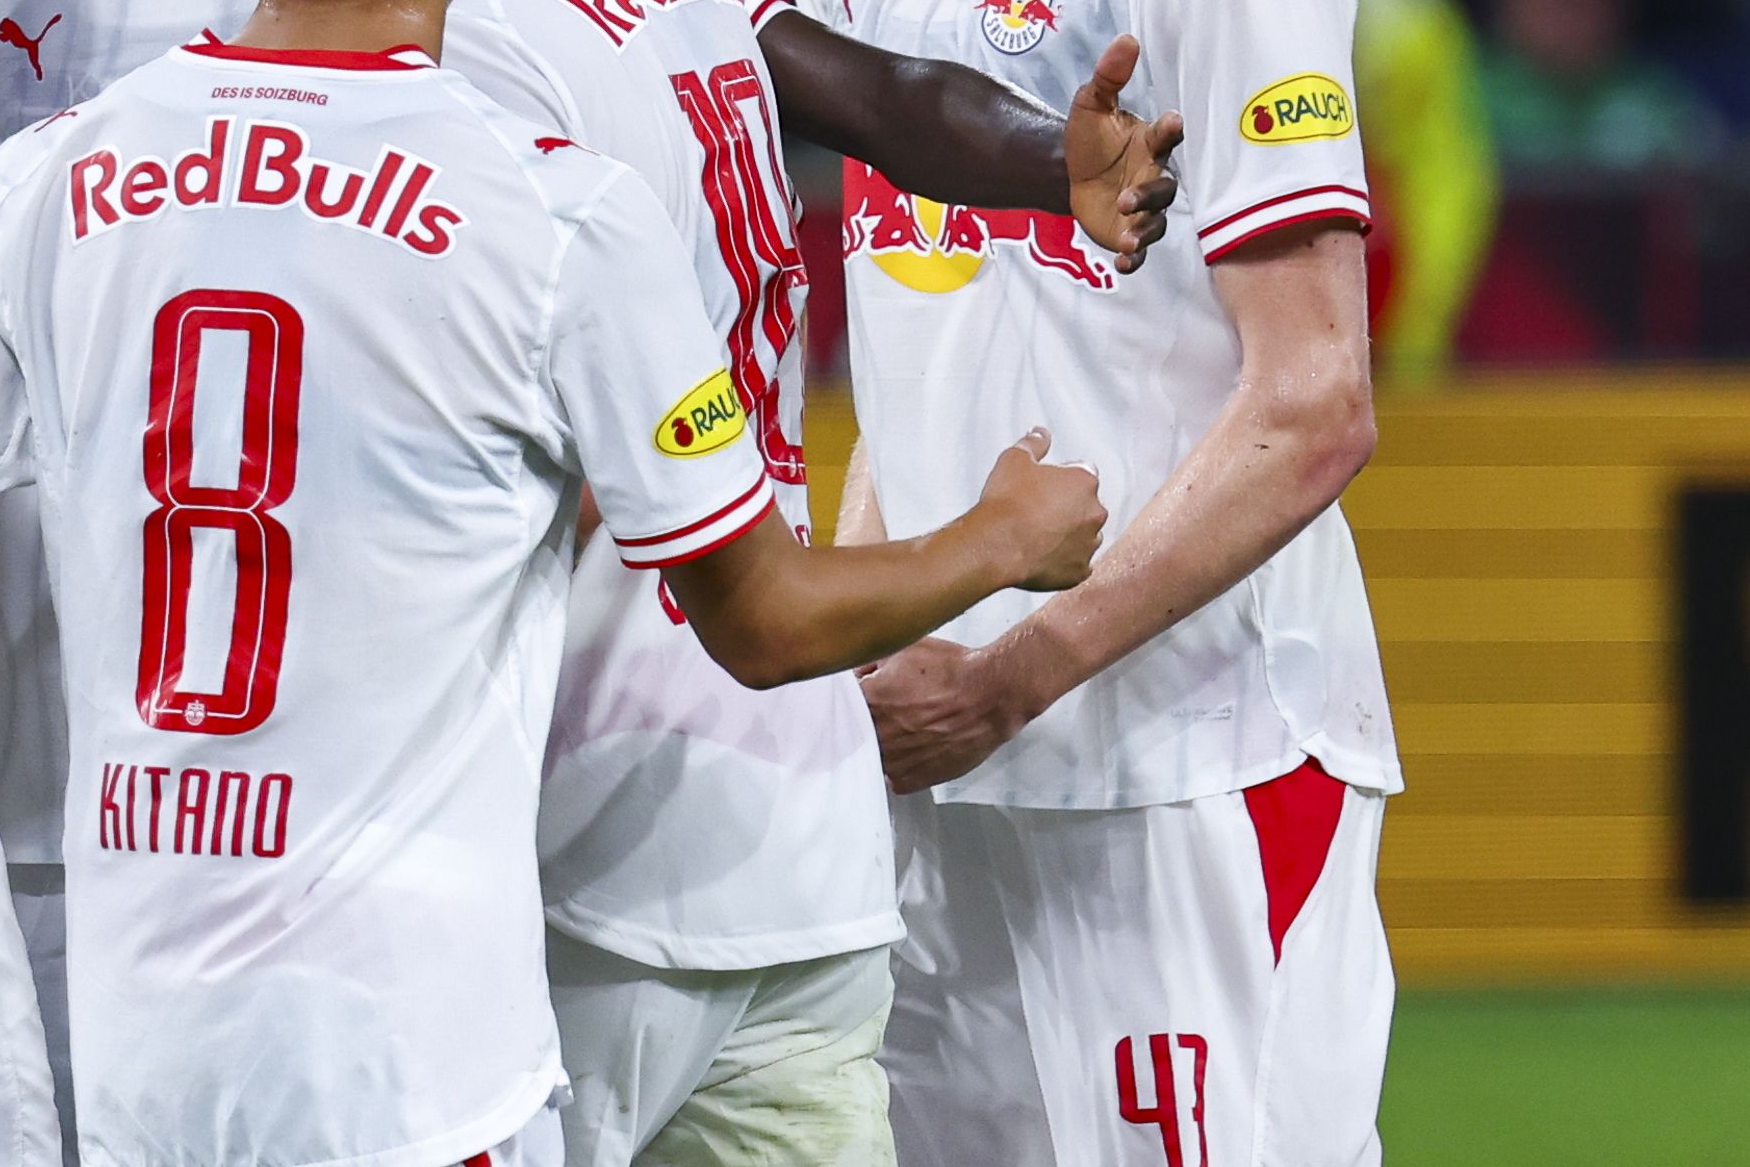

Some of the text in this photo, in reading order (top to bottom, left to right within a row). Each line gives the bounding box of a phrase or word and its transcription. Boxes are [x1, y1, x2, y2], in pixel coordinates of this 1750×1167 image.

[986, 17, 1037, 50] SALZBURG
[211, 87, 330, 106] DES IS SOIZBURG
[1274, 92, 1349, 127] RAUCH
[136, 288, 304, 735] 8
[99, 761, 294, 859] KITANO
